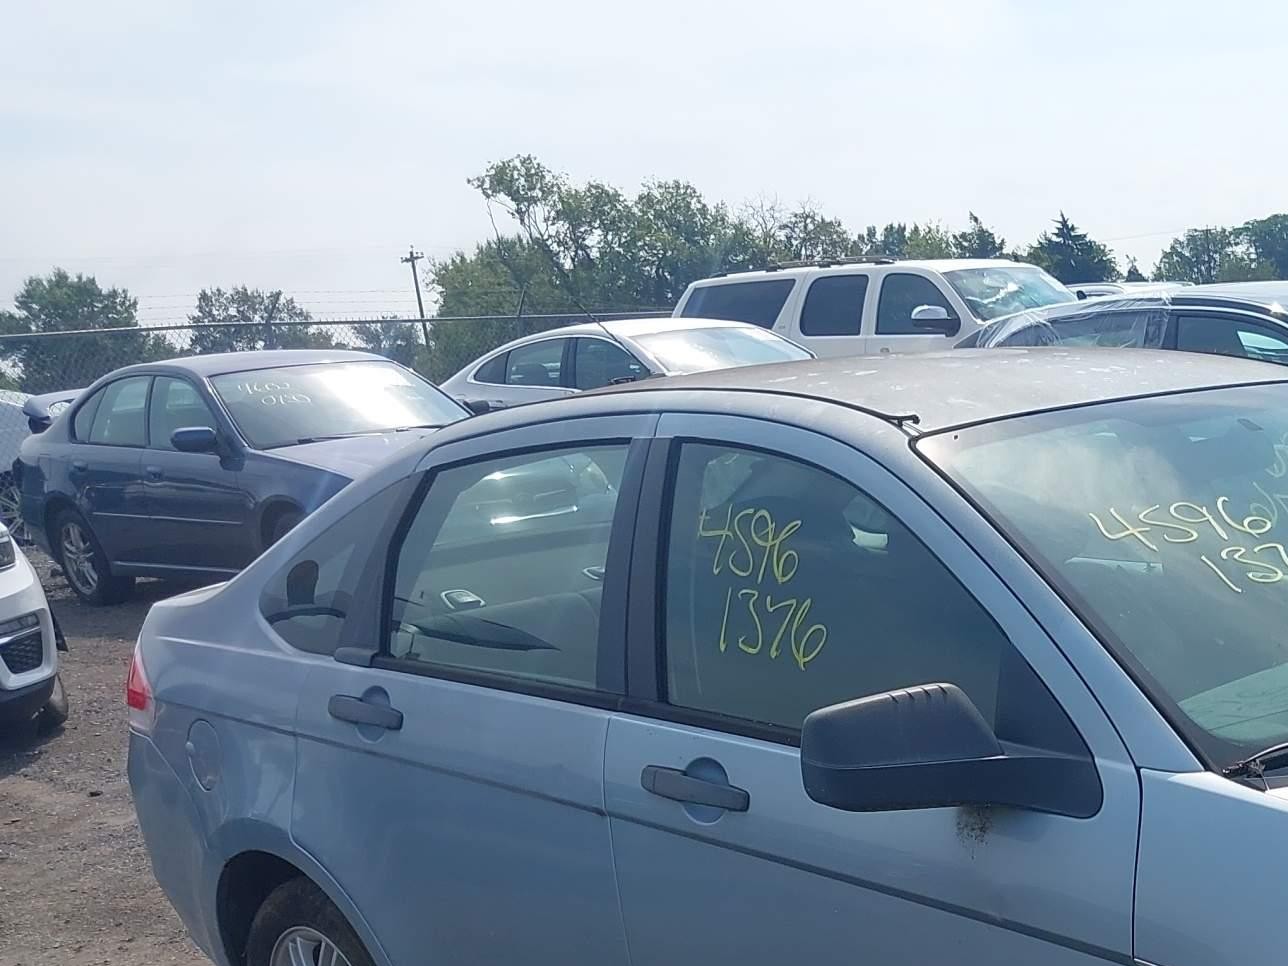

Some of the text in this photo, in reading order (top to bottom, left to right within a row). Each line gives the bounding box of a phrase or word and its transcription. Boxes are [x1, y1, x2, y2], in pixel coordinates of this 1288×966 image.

[697, 504, 802, 584] 4596
[1089, 497, 1271, 552] 4596
[720, 587, 827, 671] 1376
